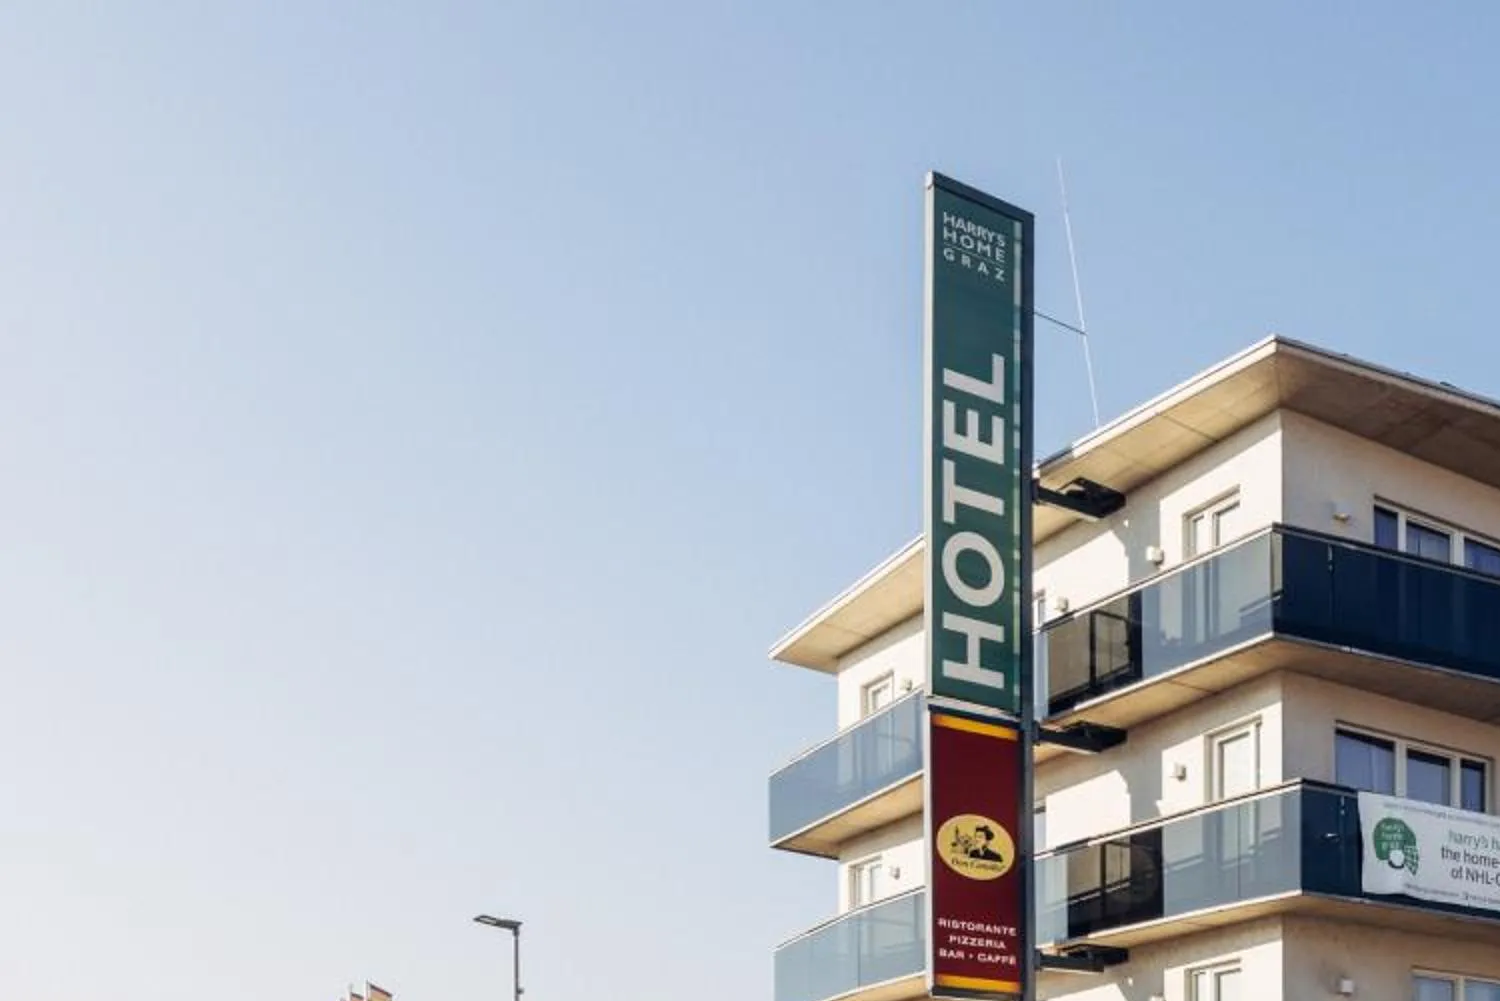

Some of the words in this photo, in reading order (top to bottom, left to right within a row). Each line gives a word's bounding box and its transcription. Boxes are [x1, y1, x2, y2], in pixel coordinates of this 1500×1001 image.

[943, 226, 1006, 263] HOME
[943, 247, 1005, 282] GRAZ
[942, 352, 1005, 690] HOTEL
[1441, 844, 1461, 862] the
[1450, 865, 1463, 880] of
[937, 917, 1017, 937] RISTORANTE
[948, 935, 1007, 950] PIZZERIA
[938, 947, 965, 960] BAR
